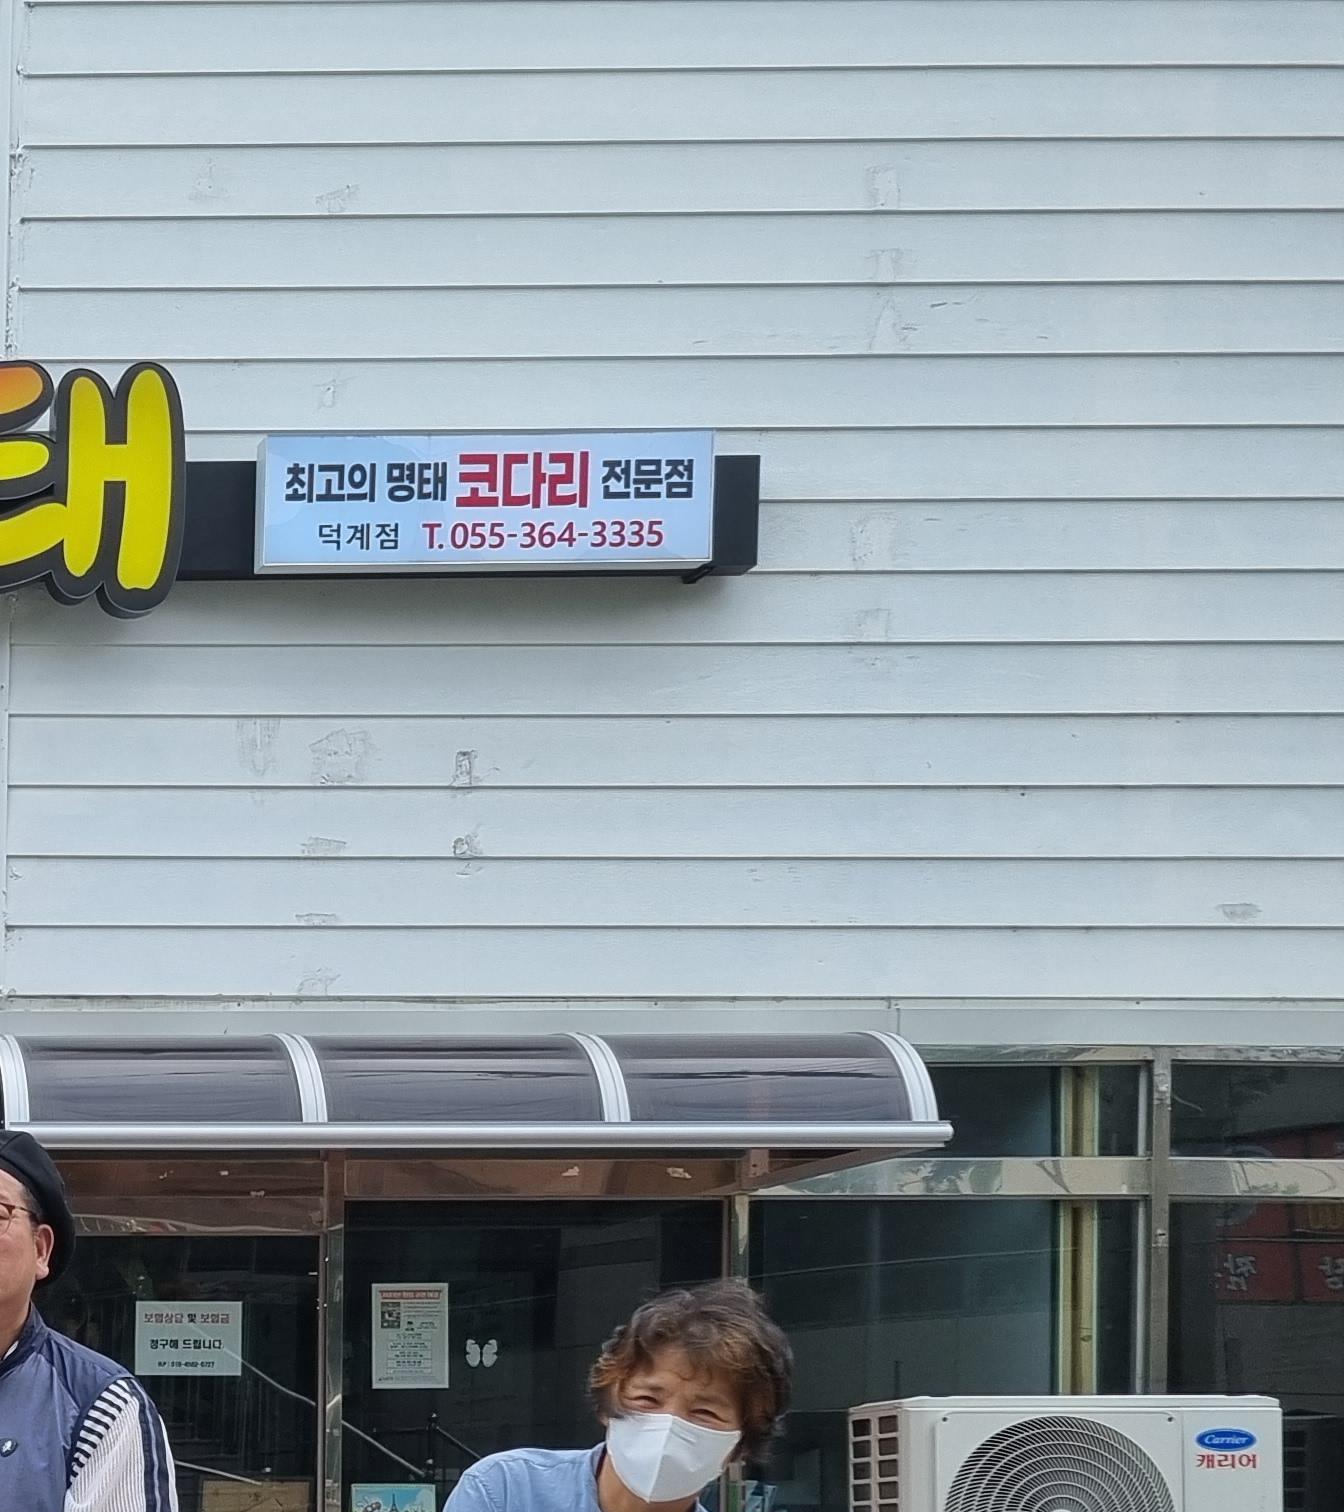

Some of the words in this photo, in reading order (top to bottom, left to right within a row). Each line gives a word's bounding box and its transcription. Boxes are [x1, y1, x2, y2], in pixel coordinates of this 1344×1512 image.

[285, 462, 376, 503] 최고의
[386, 462, 447, 502] 명태
[455, 451, 590, 509] 코다리
[601, 459, 694, 499] 전문점
[318, 522, 400, 551] 덕계점
[1204, 1434, 1250, 1445] Carrier
[1196, 1453, 1257, 1469] 캐리어
